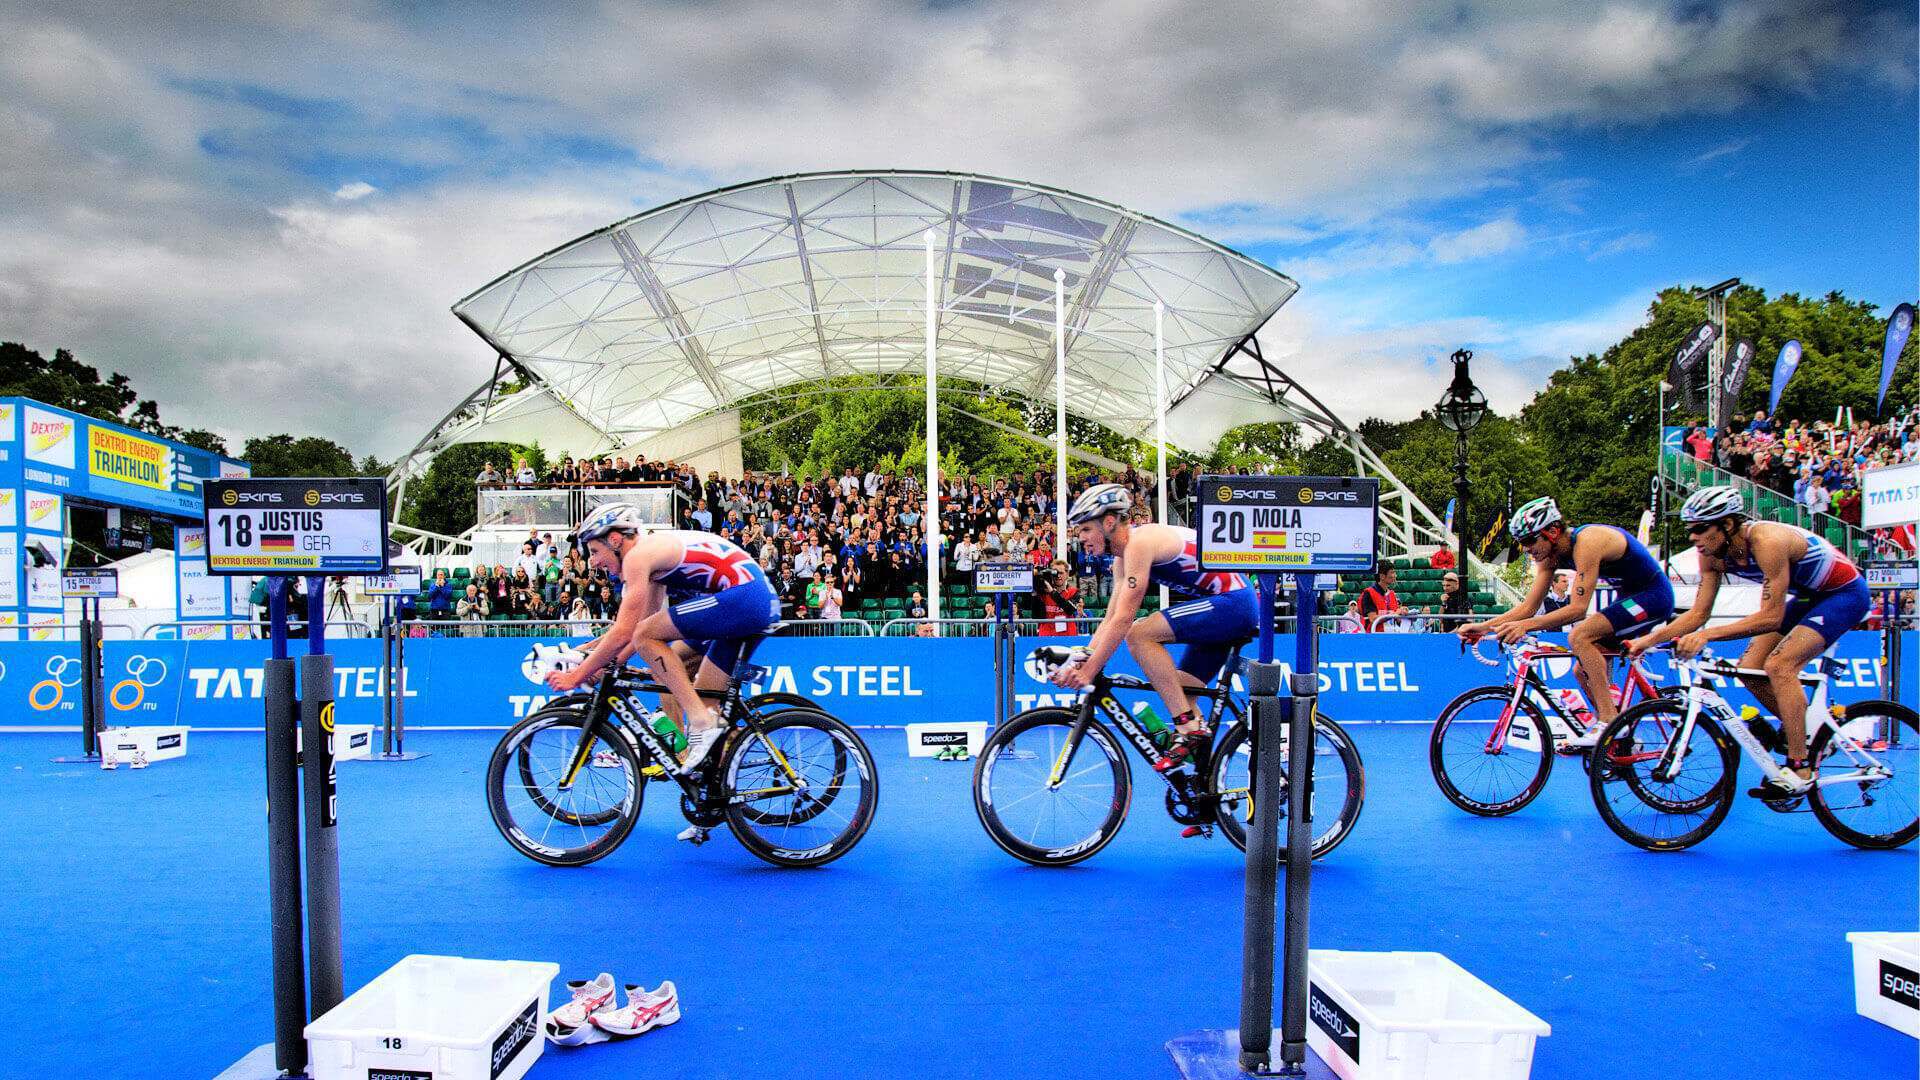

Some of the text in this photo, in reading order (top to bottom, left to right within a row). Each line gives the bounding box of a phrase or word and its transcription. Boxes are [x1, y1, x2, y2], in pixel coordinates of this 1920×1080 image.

[31, 421, 65, 434] DEXTRO
[95, 431, 160, 462] DEXTRO ENERGY
[95, 449, 160, 484] TRIATHLON
[238, 492, 365, 503] SKINS SKINS
[1232, 489, 1358, 501] SKINS SKINS
[1869, 488, 1902, 505] TATA
[218, 511, 324, 547] 18 JUSTUS
[1211, 508, 1302, 544] 20 MOLA
[302, 535, 332, 551] GER
[1294, 532, 1322, 548] ESP
[212, 556, 241, 566] DEXTRO
[242, 556, 272, 566] ENERGY
[273, 556, 314, 566] TRIATHLON
[1204, 553, 1232, 562] DEXTRO
[1234, 553, 1262, 563] ENERGY
[1264, 554, 1305, 563] TRIATHLON
[367, 576, 379, 588] 17
[979, 572, 1021, 584] 21 DOCHERTY
[1868, 570, 1879, 581] 27
[66, 579, 77, 590] 15
[1127, 576, 1137, 589] 8
[655, 655, 668, 673] 7
[811, 665, 923, 697] STEEL
[61, 701, 75, 710] ITU
[142, 702, 157, 711] ITU
[607, 696, 682, 776] boardman
[922, 733, 953, 744] speedo
[1311, 995, 1342, 1035] speedo
[382, 1037, 402, 1050] 18
[493, 1022, 524, 1071] speedo
